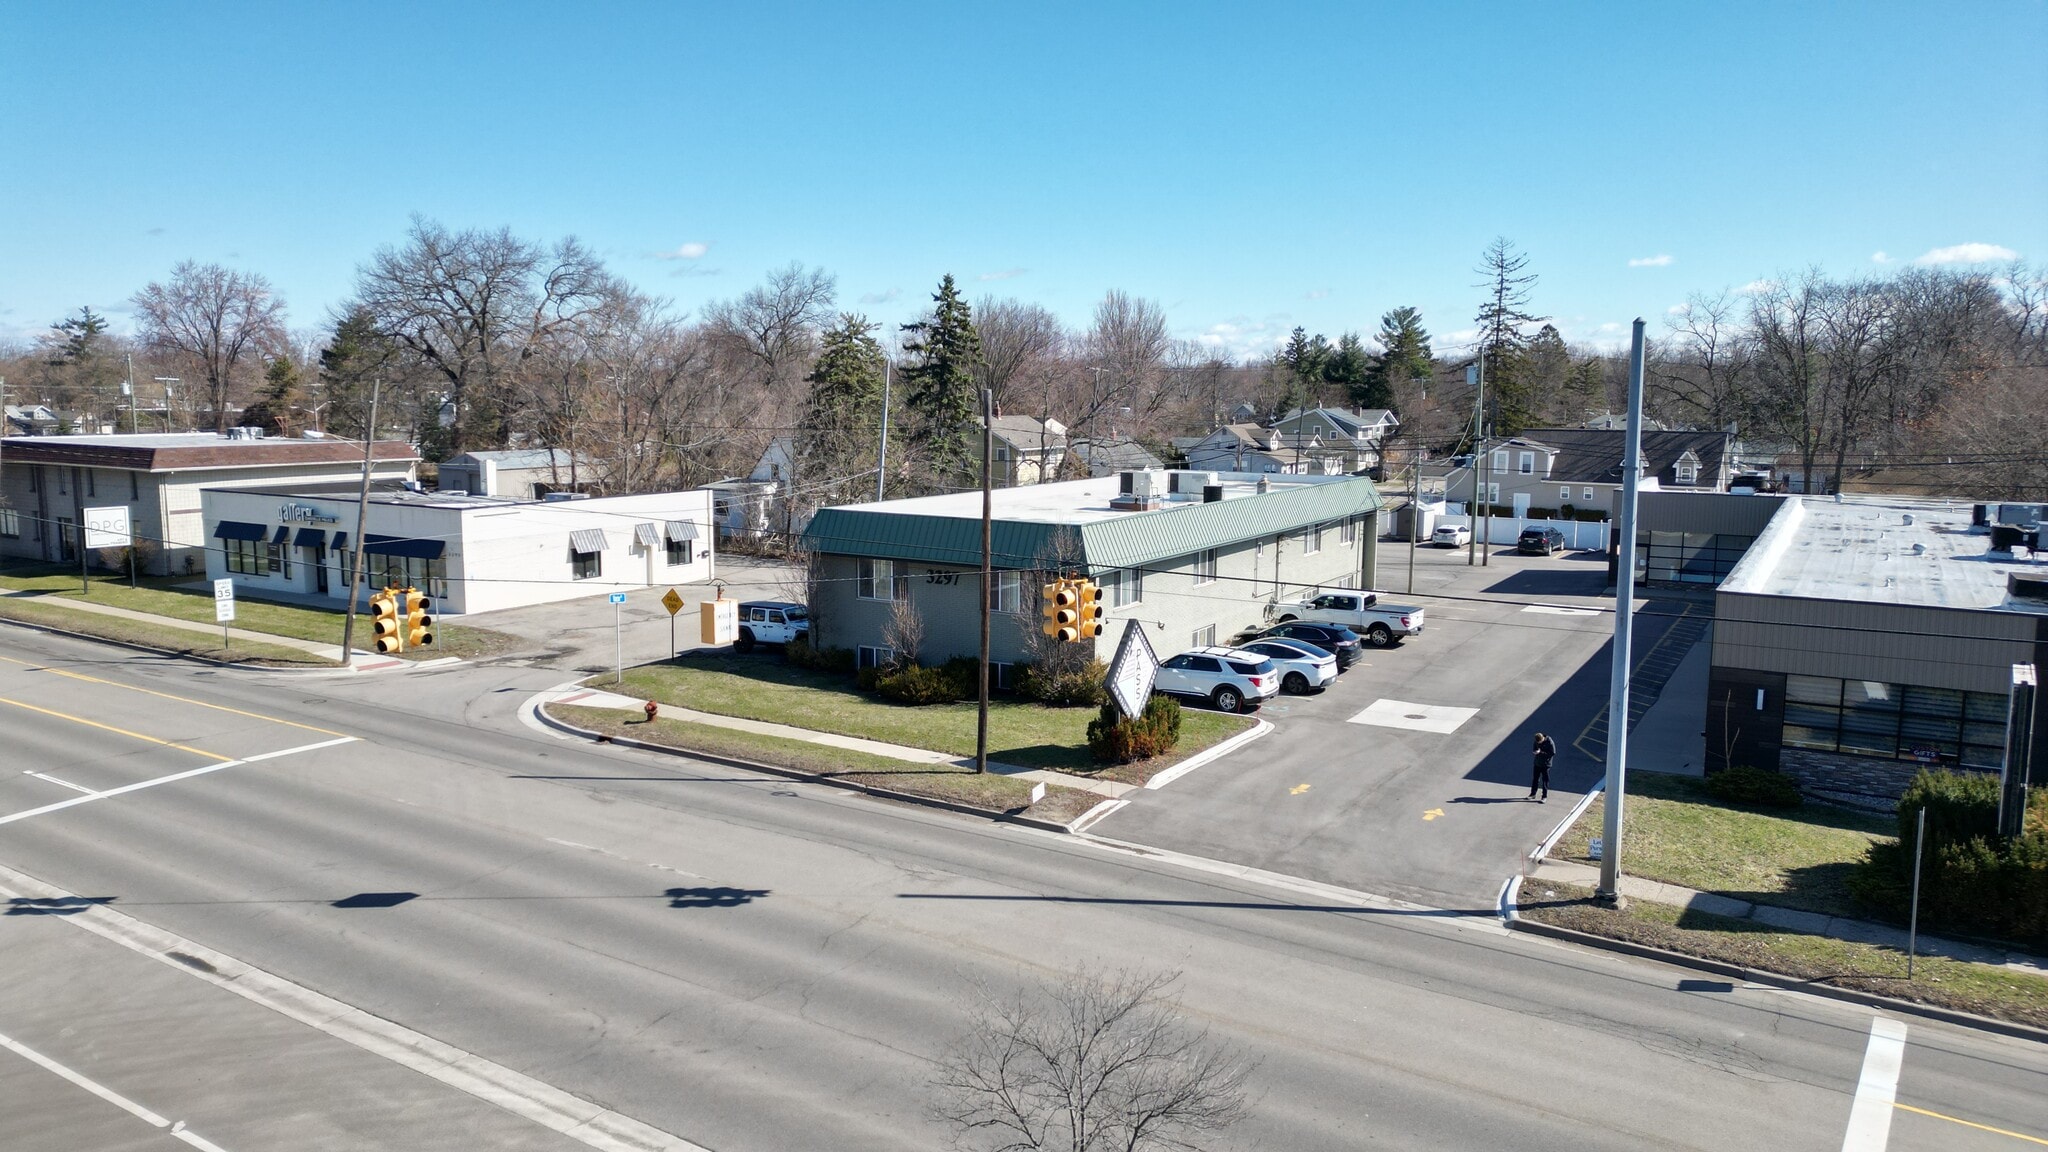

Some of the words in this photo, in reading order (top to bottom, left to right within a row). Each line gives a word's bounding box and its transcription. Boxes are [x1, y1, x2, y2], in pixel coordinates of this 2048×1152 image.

[90, 520, 125, 532] DPG
[926, 569, 960, 585] 3297
[217, 590, 231, 598] 35
